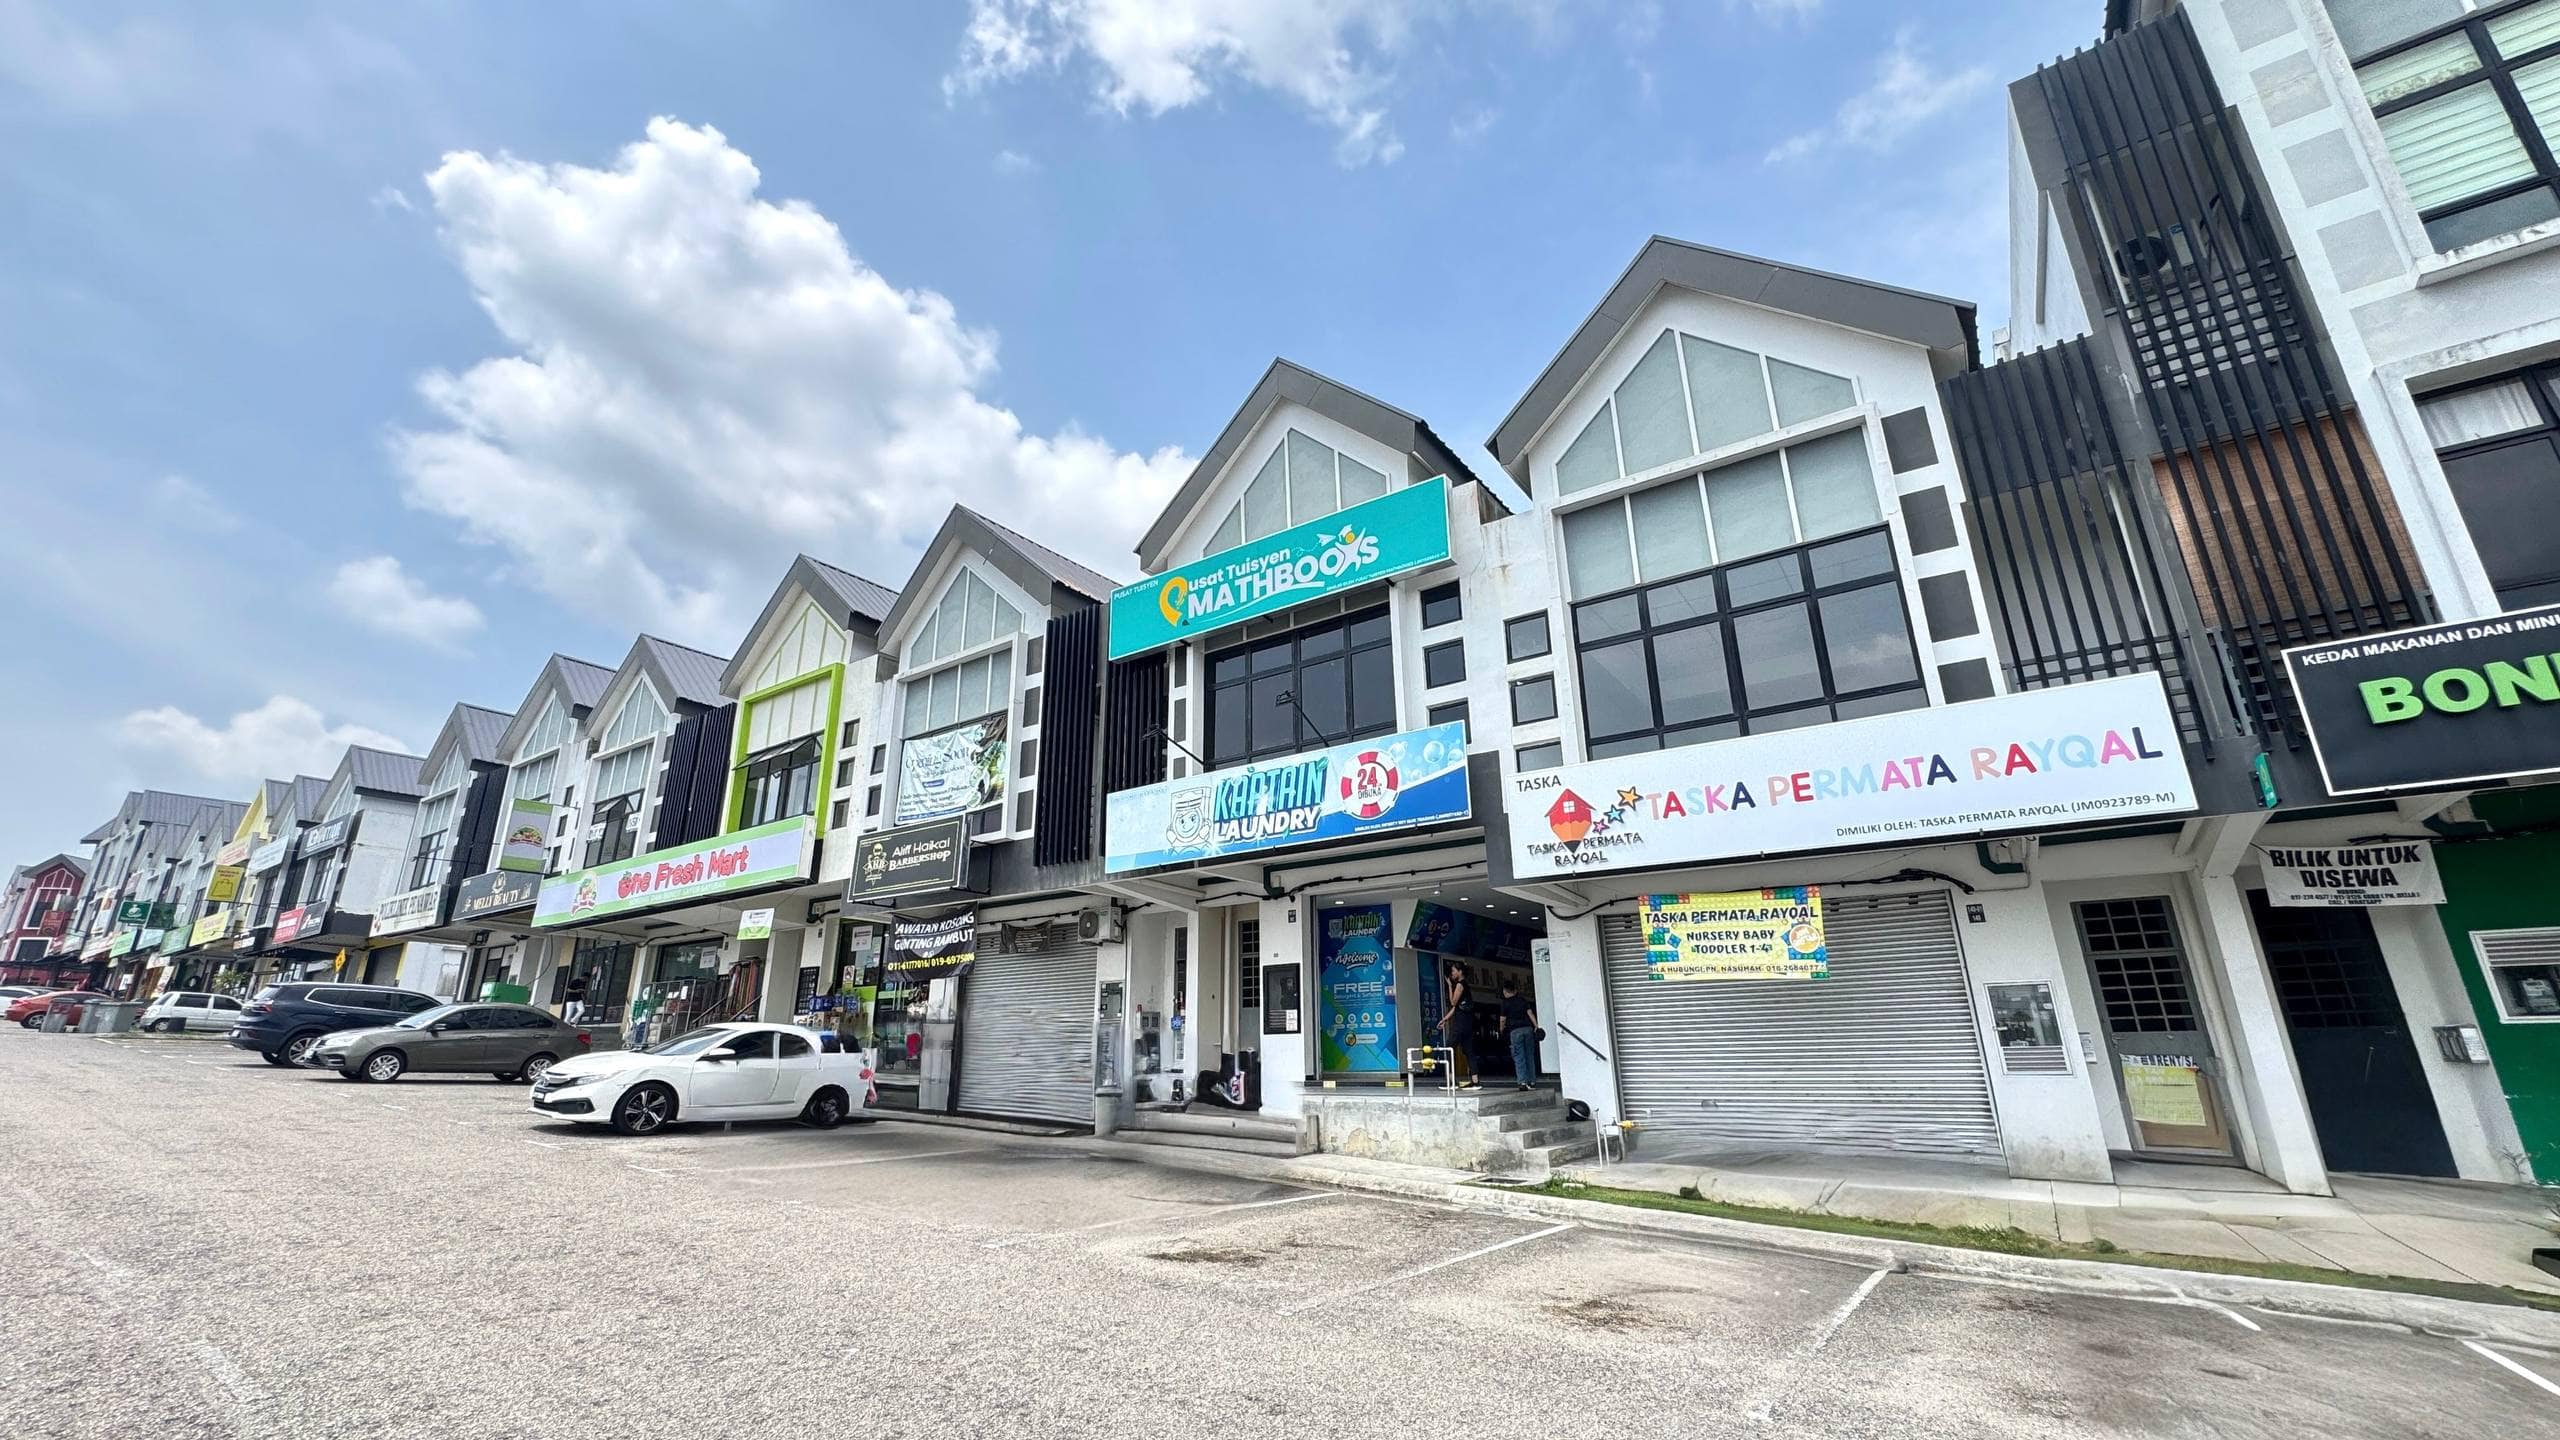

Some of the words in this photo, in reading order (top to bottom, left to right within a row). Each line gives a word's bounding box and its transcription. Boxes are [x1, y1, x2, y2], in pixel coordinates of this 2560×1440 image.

[1227, 548, 1290, 579] Tuisyen
[2302, 647, 2359, 666] KEDAI
[2363, 630, 2464, 657] MAKANAN
[2467, 622, 2513, 640] DAN
[2359, 652, 2560, 725] BON
[1357, 766, 1378, 791] 24
[1516, 775, 1562, 792] TASKA
[1646, 781, 1756, 820] TASKA
[1767, 754, 1958, 806] PERMATA
[1969, 726, 2164, 780] RAYQAL
[1214, 760, 1329, 822] KAPTAIN
[1214, 807, 1321, 843] LAUNDRY
[1836, 824, 1881, 837] DIMILIKI
[1884, 821, 1917, 832] OLEH:
[1920, 816, 1956, 828] TASKA
[1959, 809, 2016, 824] PERMATA
[2019, 803, 2069, 817] RAYQAL
[2071, 791, 2176, 813] (JM0923789-M)
[913, 837, 950, 854] Haikal
[1527, 841, 1567, 856] TASKA
[1584, 832, 1644, 849] PERMATA
[2269, 848, 2331, 868] BILIK
[2337, 844, 2421, 867] UNTUK
[618, 870, 652, 898] One
[654, 855, 704, 890] Fresh
[706, 844, 749, 880] Mart
[888, 850, 952, 871] BARBERSHOP
[2300, 867, 2399, 888] DISEWA
[1645, 912, 1688, 924] TASKA
[1691, 909, 1759, 923] PERMATA
[1686, 930, 1740, 941] NURSERY
[1743, 930, 1775, 940] BABY
[1694, 943, 1747, 954] TODDLER
[1333, 981, 1383, 994] FREE
